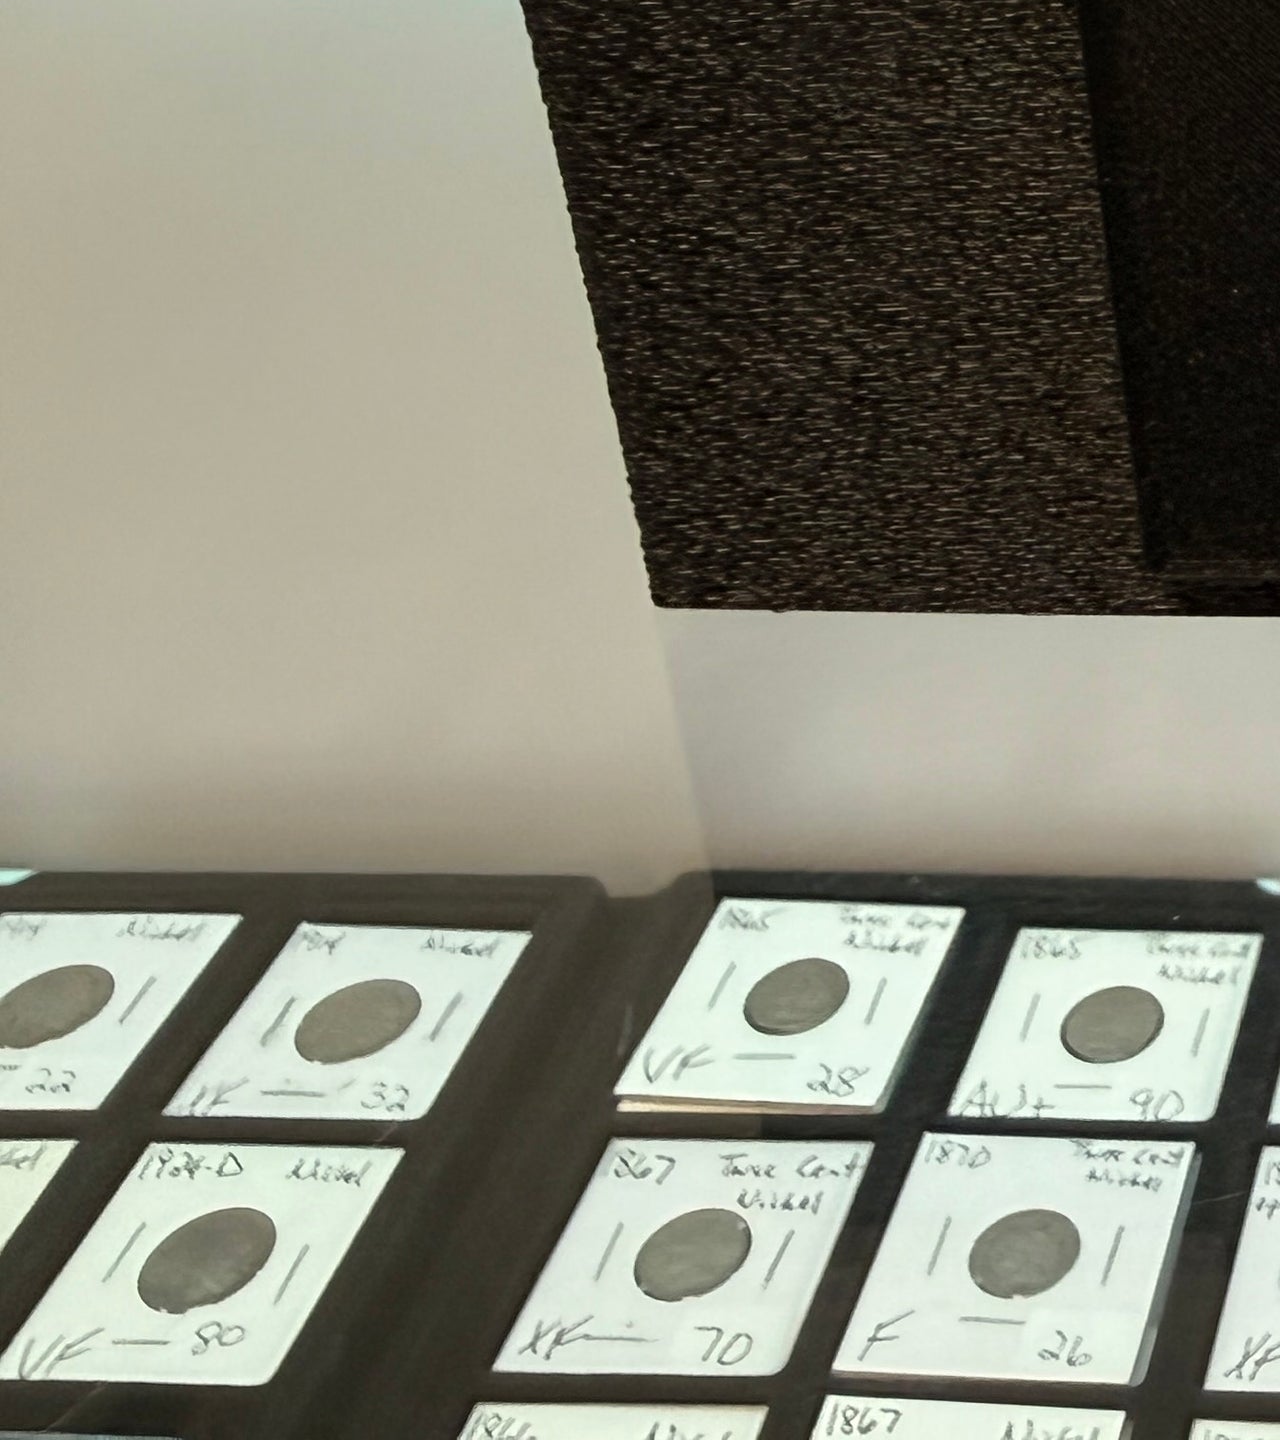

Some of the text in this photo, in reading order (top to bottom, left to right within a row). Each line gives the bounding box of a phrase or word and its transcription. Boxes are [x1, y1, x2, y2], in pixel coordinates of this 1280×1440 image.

[694, 1326, 754, 1367] 70
[1037, 1329, 1092, 1367] 26
[825, 1402, 902, 1436] 1867
